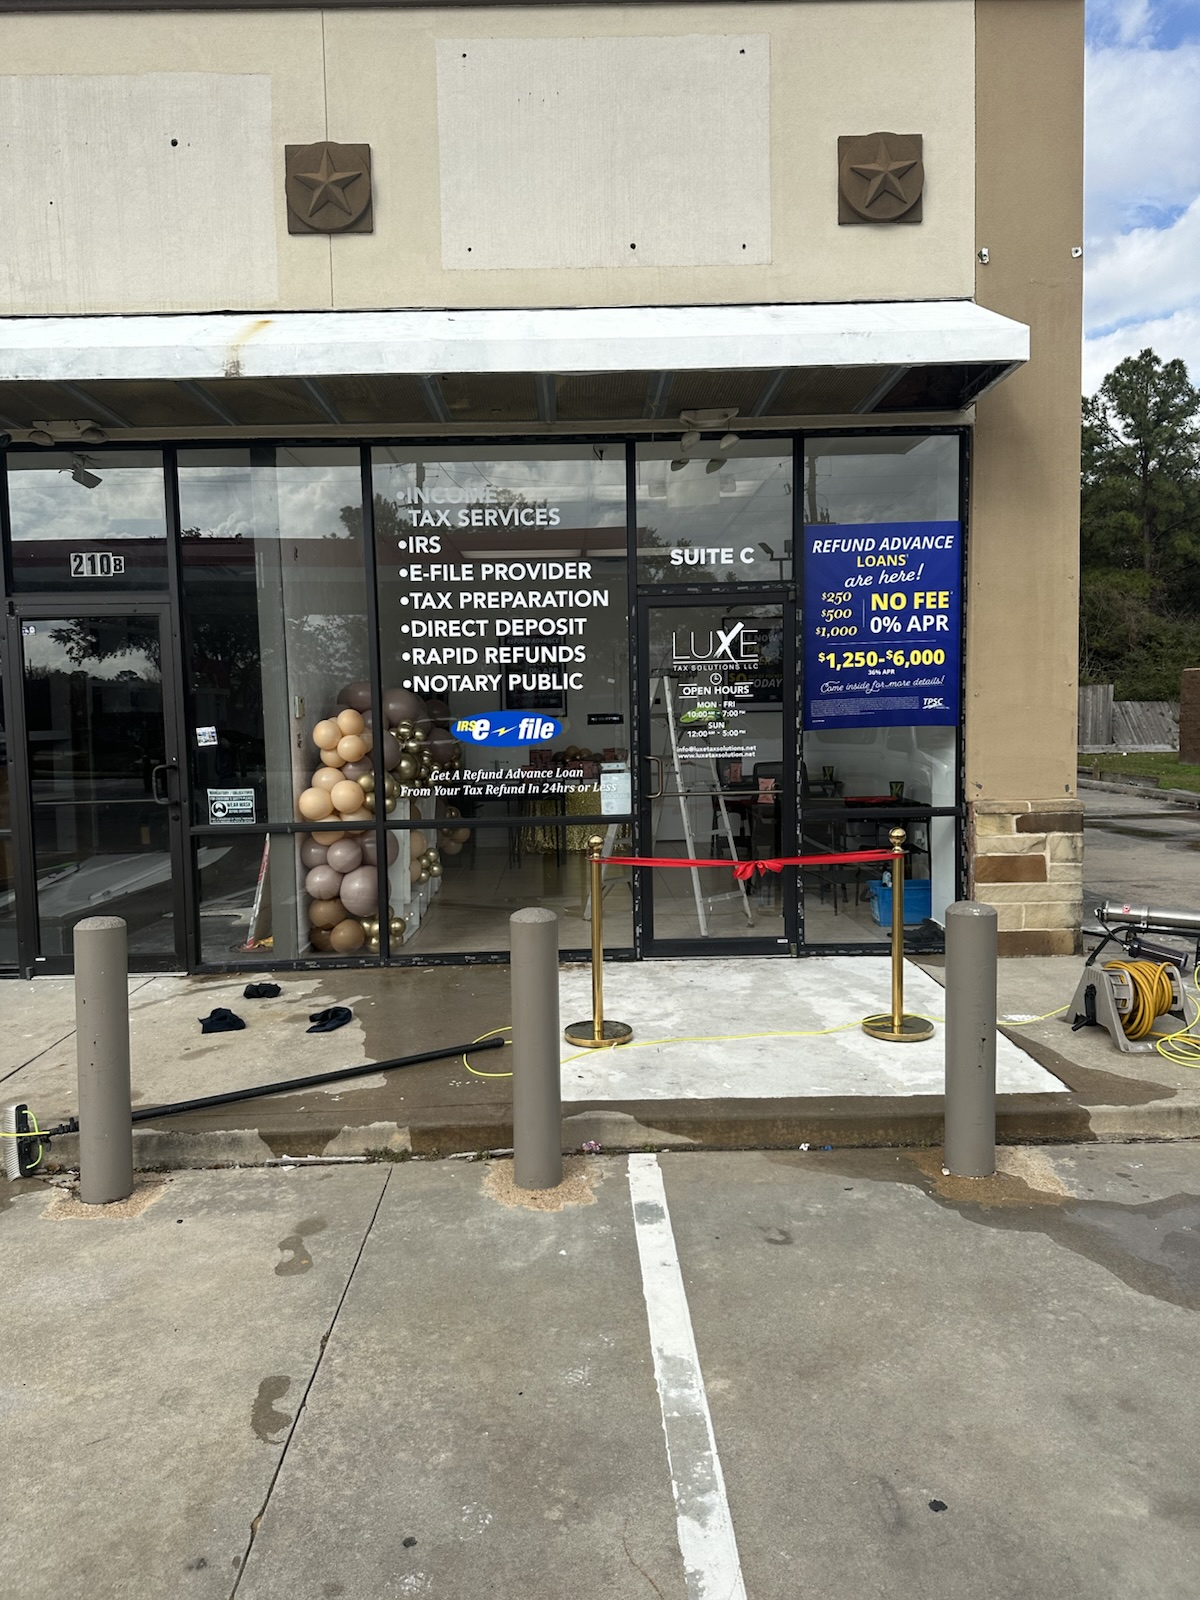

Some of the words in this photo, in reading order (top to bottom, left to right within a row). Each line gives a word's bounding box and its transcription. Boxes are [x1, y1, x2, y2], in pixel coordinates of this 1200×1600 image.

[407, 486, 498, 504] INCOME
[408, 510, 452, 527] TAX
[458, 508, 561, 526] SERVICES
[409, 536, 441, 553] IRS
[812, 539, 876, 553] REFUND
[879, 535, 954, 551] ADVANCE
[670, 548, 734, 565] SUITE
[740, 547, 755, 564] C
[409, 564, 474, 581] E-FILE
[481, 562, 592, 580] PROVIDER
[844, 576, 873, 588] are
[878, 563, 925, 584] here!
[409, 592, 453, 609] TAX
[459, 590, 609, 608] PREPARATION
[821, 591, 852, 605] $250
[871, 593, 907, 611] NO
[821, 608, 852, 622] $500
[870, 616, 902, 633] 0%
[906, 615, 950, 632] APR
[411, 620, 489, 637] DIRECT
[495, 618, 587, 635] DEPOSIT
[815, 626, 858, 638] $1,000
[672, 621, 759, 662] LUXE
[412, 648, 478, 664] RAPID
[485, 646, 586, 663] REFUNDS
[691, 663, 740, 671] SOLUTIONS
[743, 662, 758, 670] LLC
[413, 675, 502, 692] NOTARY
[508, 673, 583, 690] PUBLIC
[683, 687, 712, 695] OPEN
[714, 685, 749, 694] HOURS
[820, 681, 843, 694] Come
[845, 681, 870, 691] inside
[912, 675, 946, 687] details!
[922, 697, 943, 705] TPSC
[457, 720, 476, 732] IRS
[472, 718, 490, 741] e
[518, 717, 555, 740] file
[676, 745, 757, 753] info@luxetaxsolutions.net
[677, 751, 756, 759] www.luxetaxsolution.net
[431, 770, 450, 781] Get
[452, 770, 461, 780] A
[464, 769, 502, 782] Refund
[505, 768, 554, 780] Advance
[555, 768, 584, 779] Loan
[400, 786, 431, 797] From
[434, 785, 460, 796] Your
[462, 785, 482, 796] Tax
[485, 784, 524, 798] Refund
[527, 784, 540, 794] In
[542, 783, 574, 794] 24hrs
[578, 785, 590, 793] or
[592, 782, 617, 792] Less
